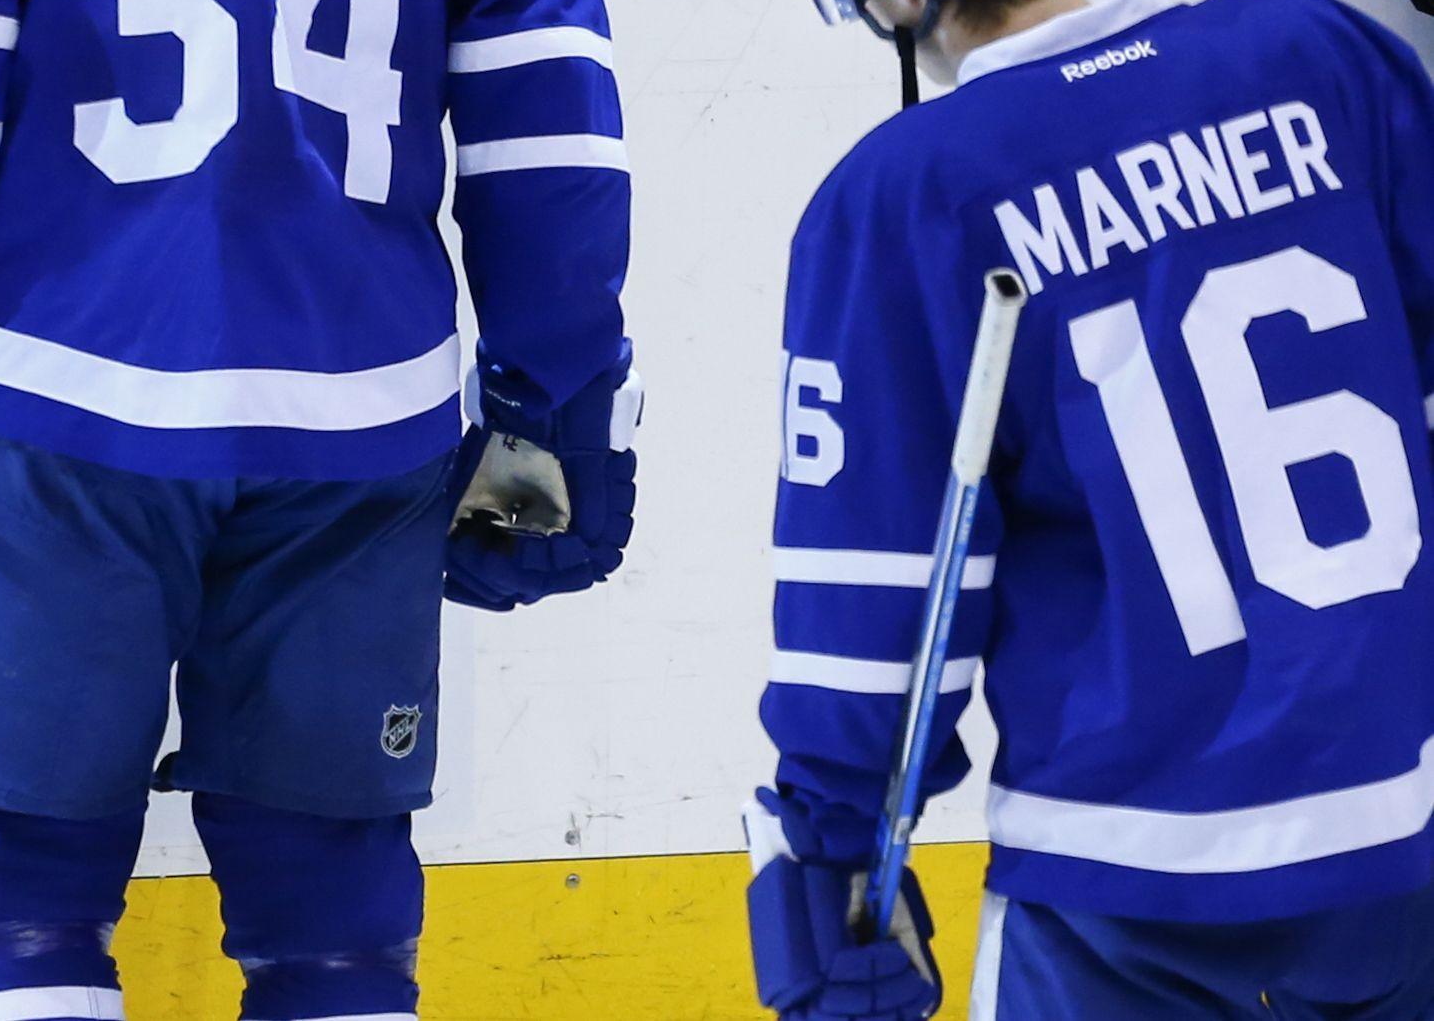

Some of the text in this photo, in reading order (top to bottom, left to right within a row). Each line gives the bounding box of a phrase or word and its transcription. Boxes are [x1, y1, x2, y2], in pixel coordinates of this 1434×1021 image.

[1060, 40, 1158, 83] Reebok
[992, 100, 1344, 297] MARNER
[1067, 244, 1423, 657] 16
